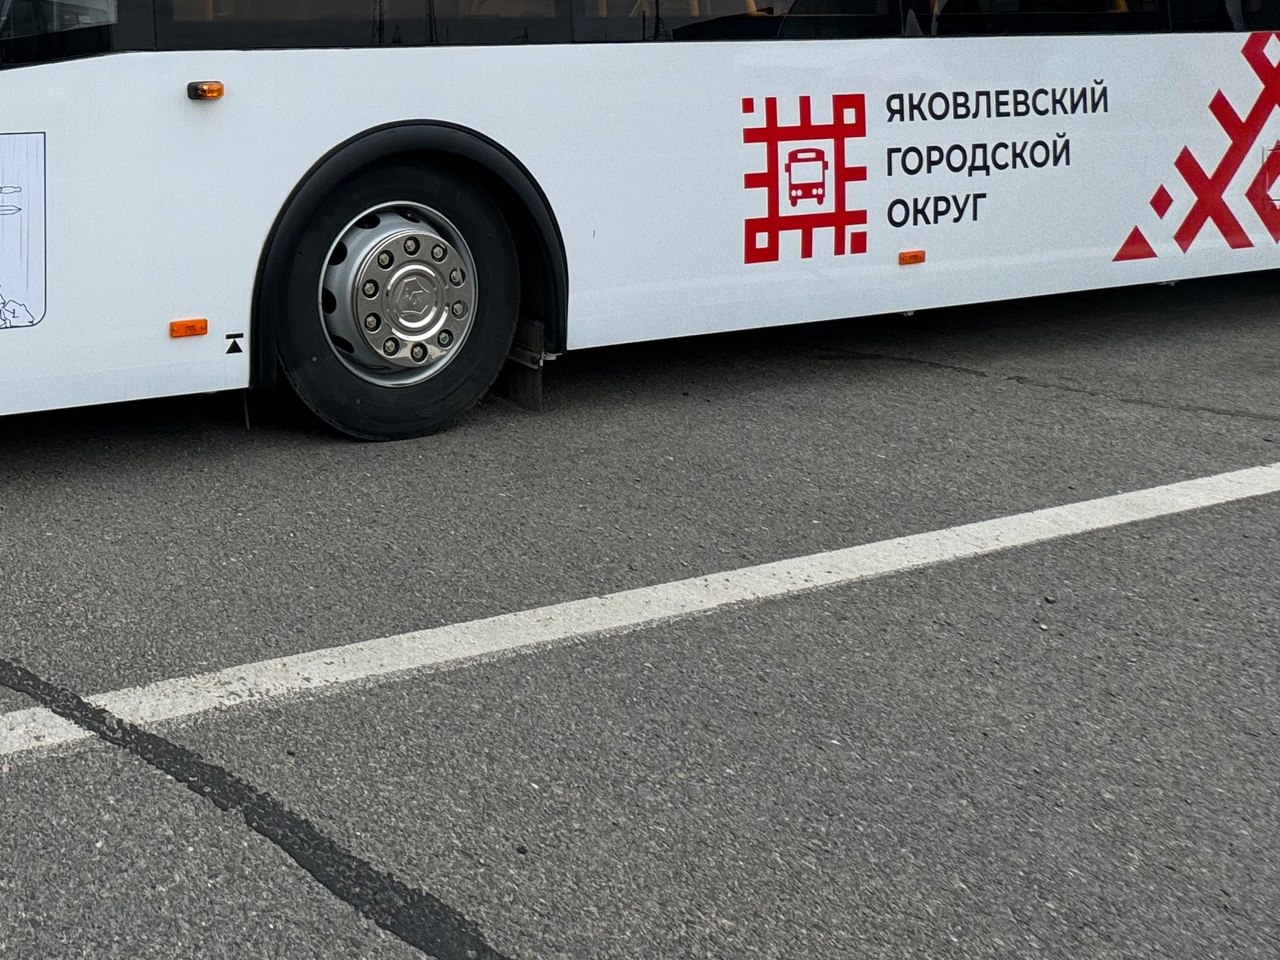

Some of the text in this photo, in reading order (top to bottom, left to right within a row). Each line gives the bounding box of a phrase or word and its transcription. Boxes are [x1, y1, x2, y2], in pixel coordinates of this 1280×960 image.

[885, 78, 1109, 123] ЯКОВЛЕВСКИЙ
[886, 131, 1071, 178] ГОРОДСКОЙ
[887, 192, 987, 228] ОКРУГ
